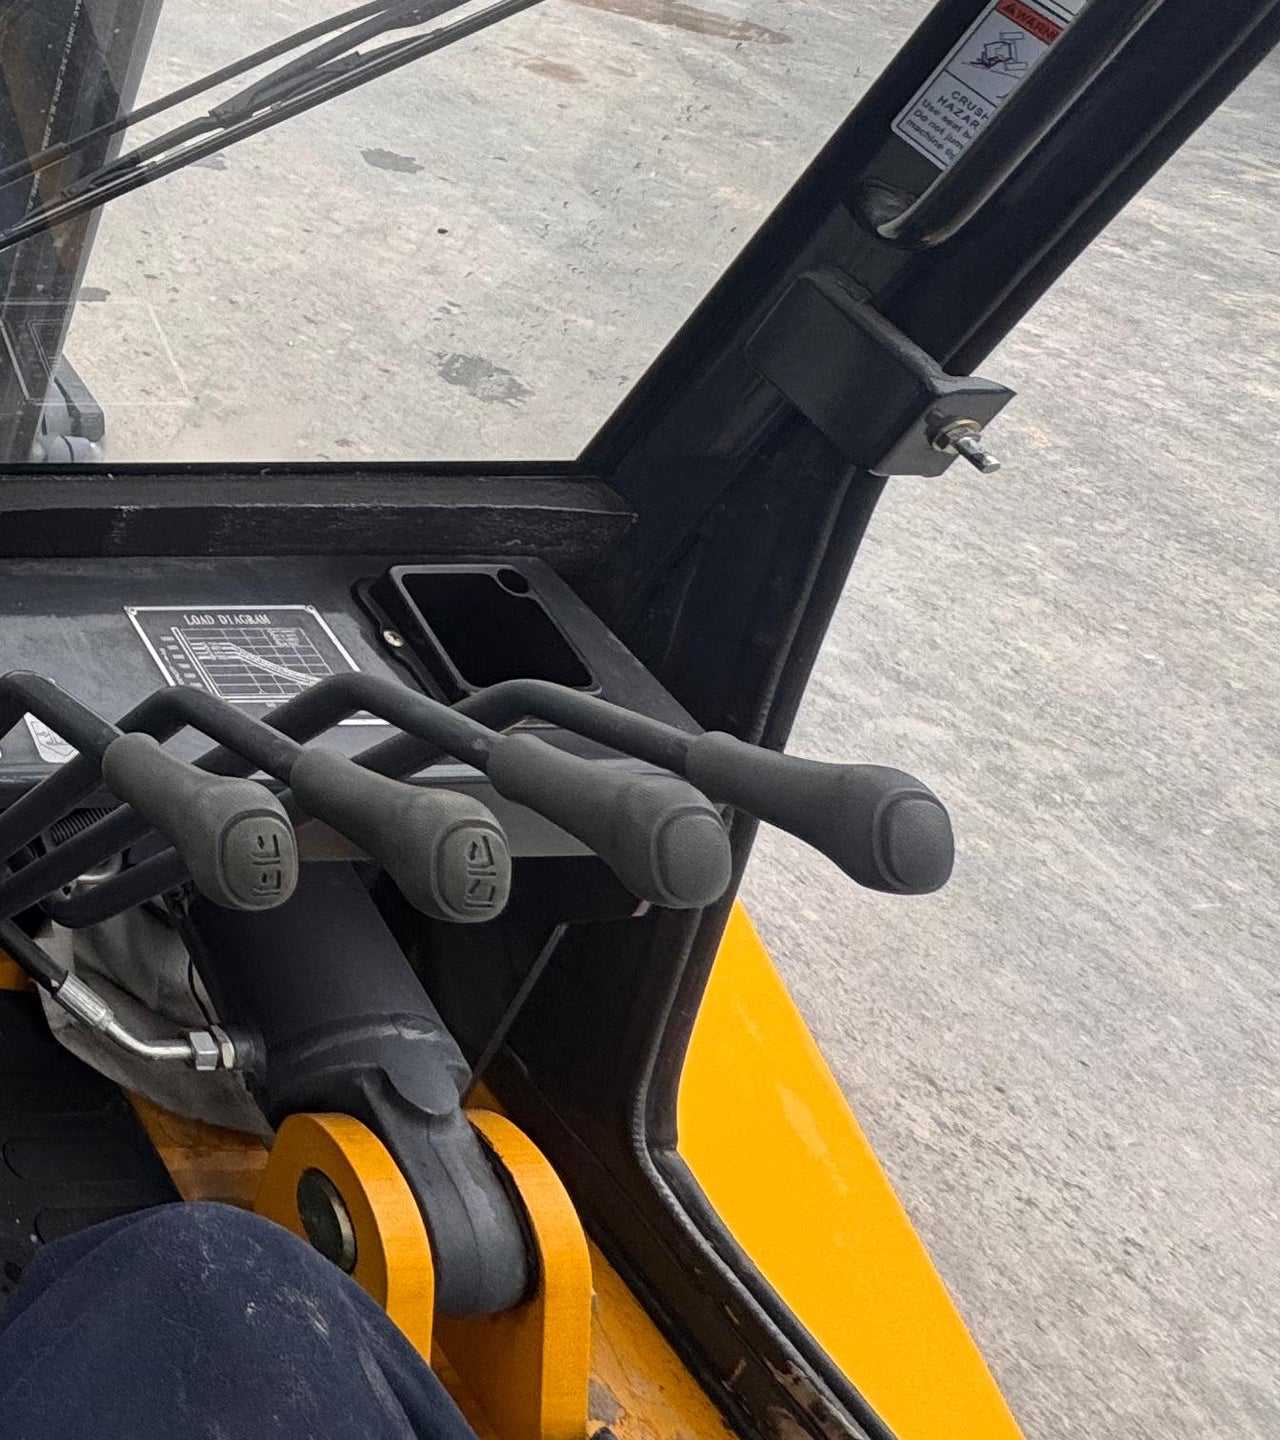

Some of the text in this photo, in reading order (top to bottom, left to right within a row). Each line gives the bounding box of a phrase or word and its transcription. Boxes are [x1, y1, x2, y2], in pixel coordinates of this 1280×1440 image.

[936, 95, 980, 130] HAZAR
[942, 130, 965, 151] jum
[184, 614, 272, 626] LOAD DIAGRAM
